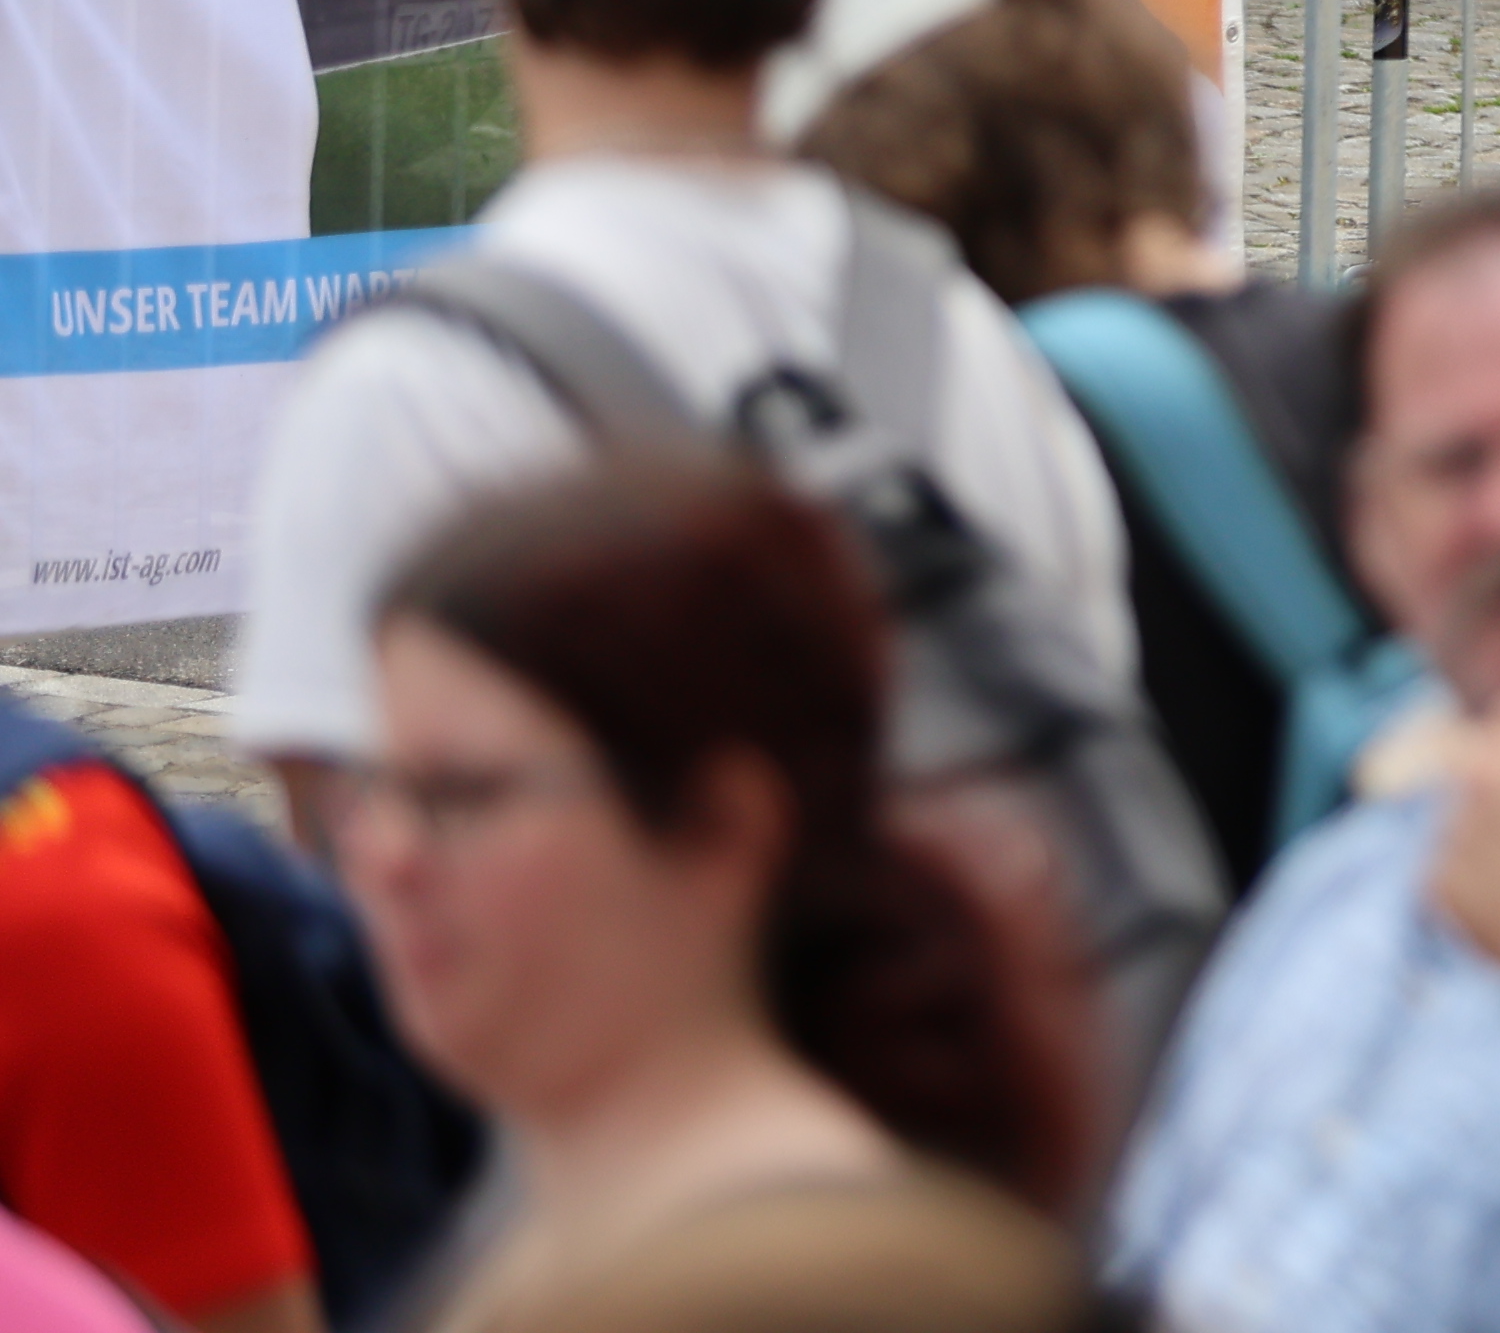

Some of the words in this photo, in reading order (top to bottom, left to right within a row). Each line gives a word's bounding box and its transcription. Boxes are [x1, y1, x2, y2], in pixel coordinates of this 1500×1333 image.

[52, 286, 180, 337] UNSER
[186, 278, 297, 330] TEAM
[33, 546, 222, 586] www.ist-ag.com
